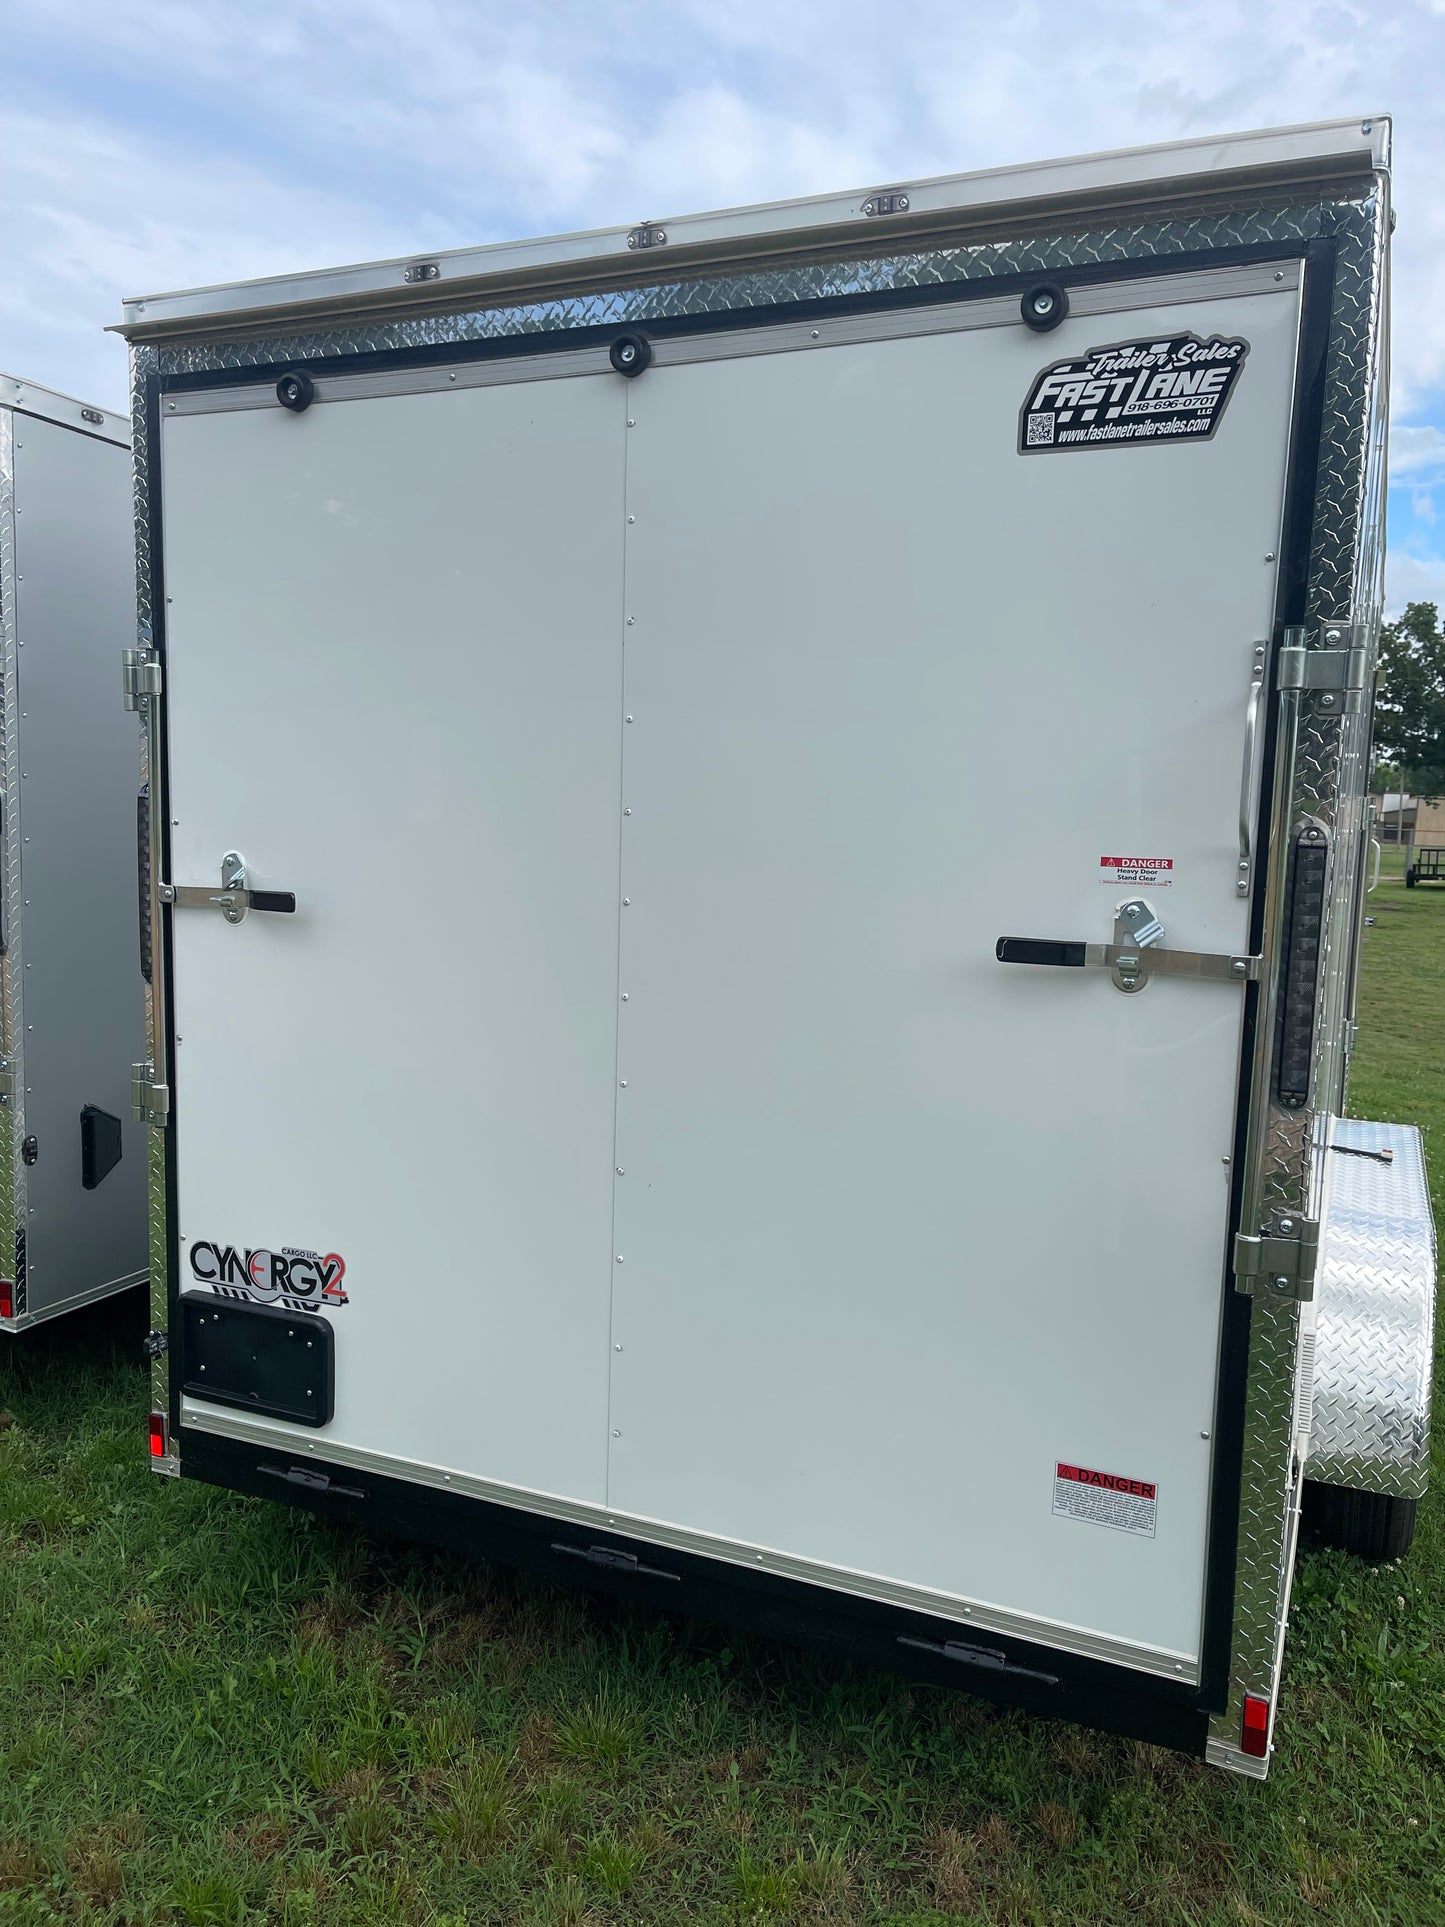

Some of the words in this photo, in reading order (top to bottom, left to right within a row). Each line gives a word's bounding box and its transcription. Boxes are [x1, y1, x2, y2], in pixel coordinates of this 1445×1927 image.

[1091, 351, 1169, 376] Trailer
[1175, 342, 1242, 367] Sales
[1126, 396, 1216, 413] 918-696-0701
[1057, 417, 1211, 443] www.fastlanetrailersales.com
[1121, 858, 1169, 868] DANGER
[281, 1247, 306, 1259] CARGO
[306, 1250, 318, 1260] LLC
[1078, 1468, 1153, 1497] DANGER
